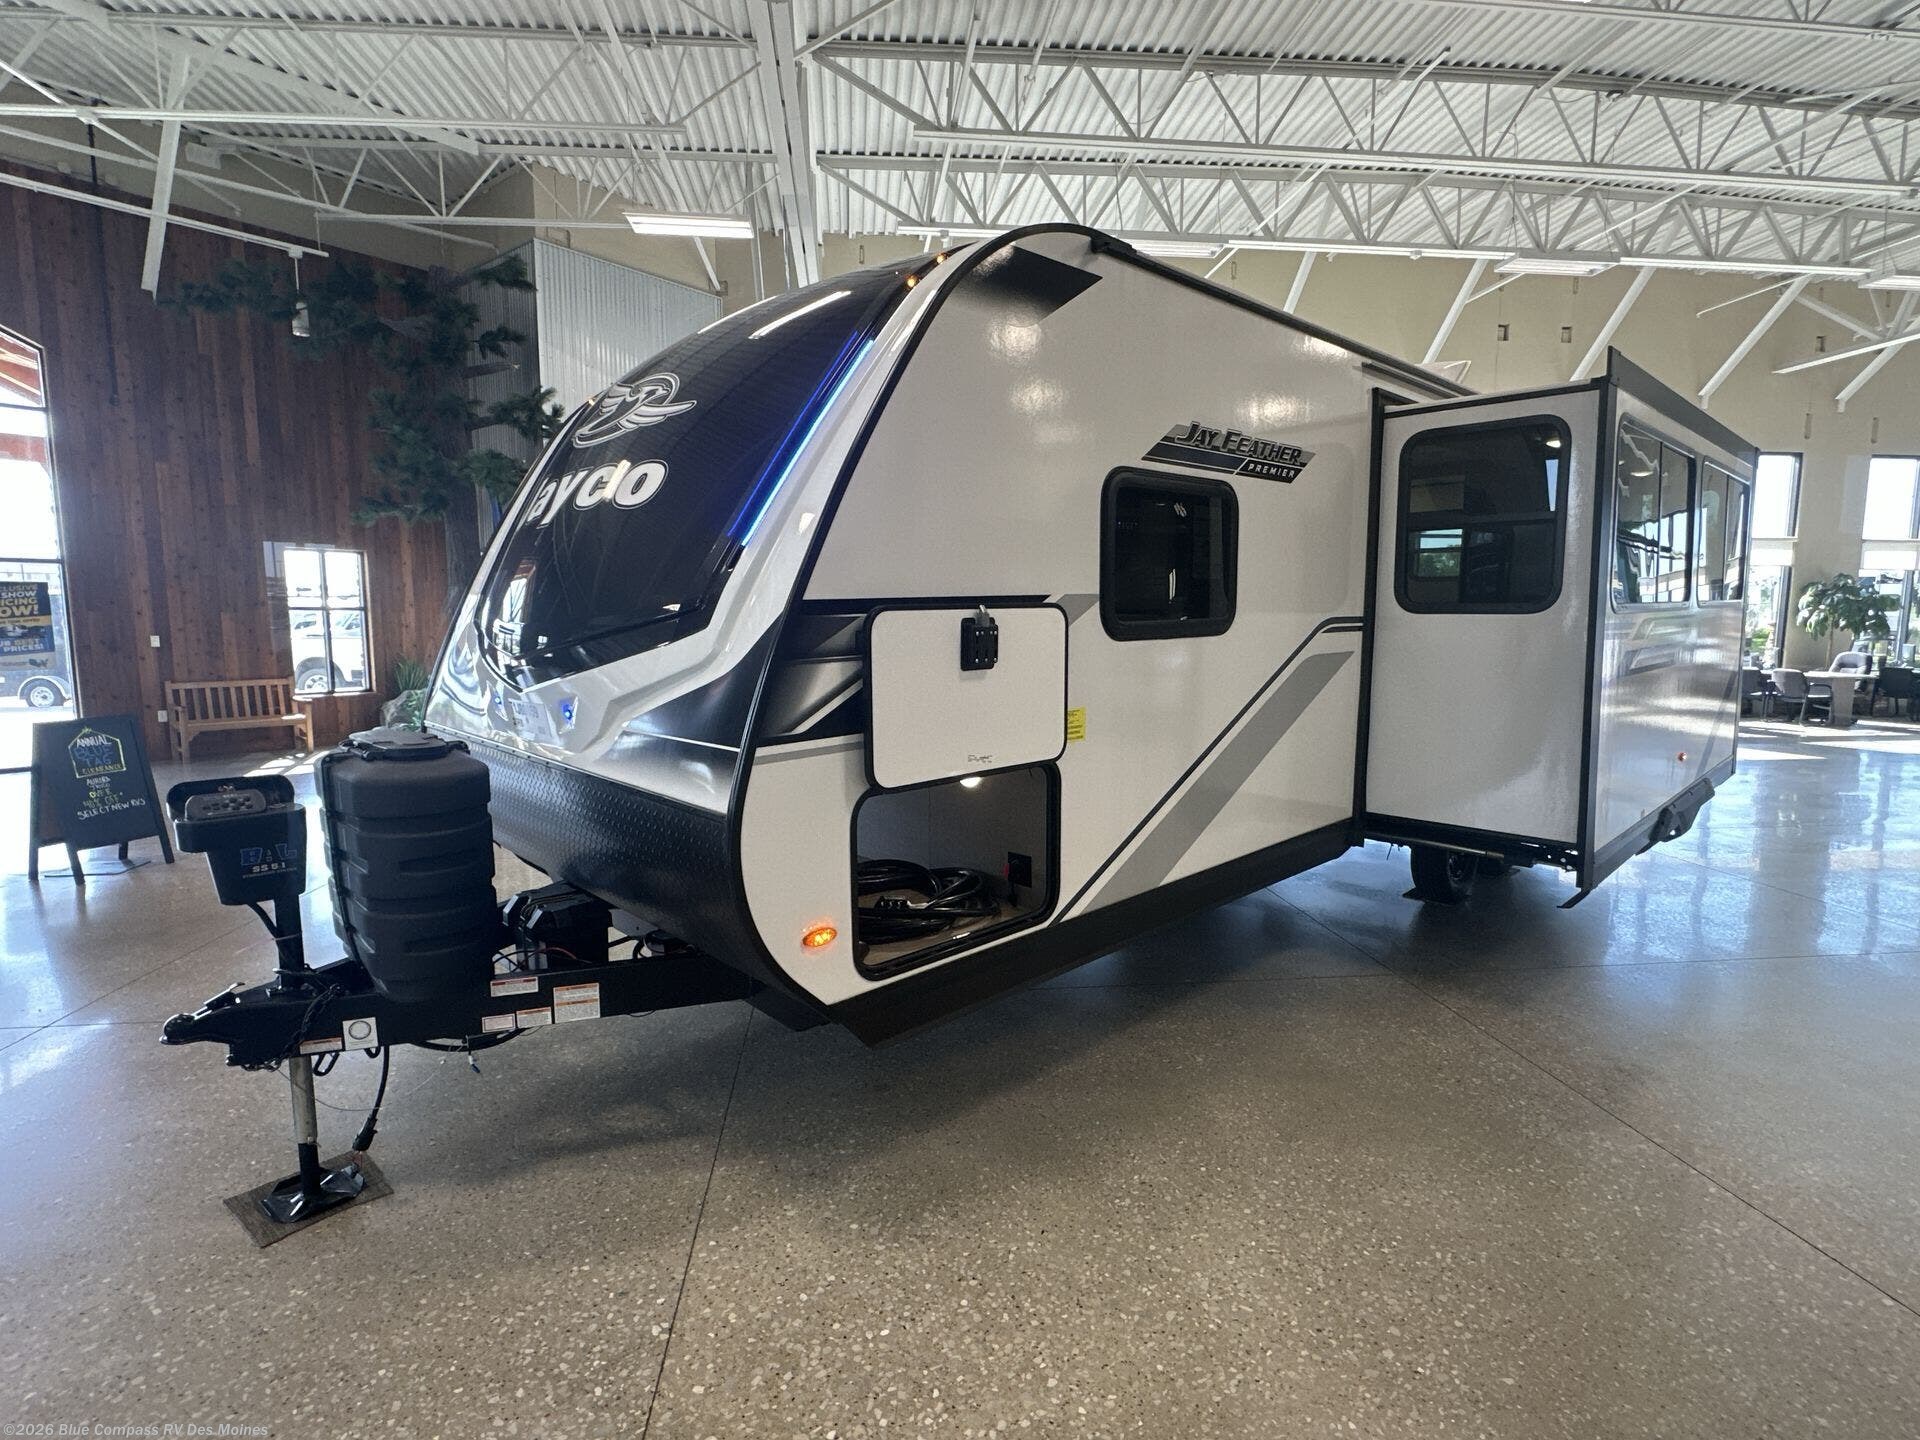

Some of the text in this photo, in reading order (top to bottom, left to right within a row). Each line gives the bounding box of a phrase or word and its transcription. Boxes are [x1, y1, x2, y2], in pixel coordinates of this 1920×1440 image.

[1220, 428, 1303, 465] FEATHER
[1248, 463, 1295, 478] PREMIER
[525, 459, 669, 529] ayco
[1, 590, 36, 599] SHOW
[0, 597, 38, 607] ICING
[0, 604, 39, 618] OW!
[76, 734, 112, 748] ANNUAL
[73, 745, 113, 760] BLUE
[83, 754, 112, 768] TAG
[77, 805, 110, 820] SELECT
[111, 801, 129, 813] NEW
